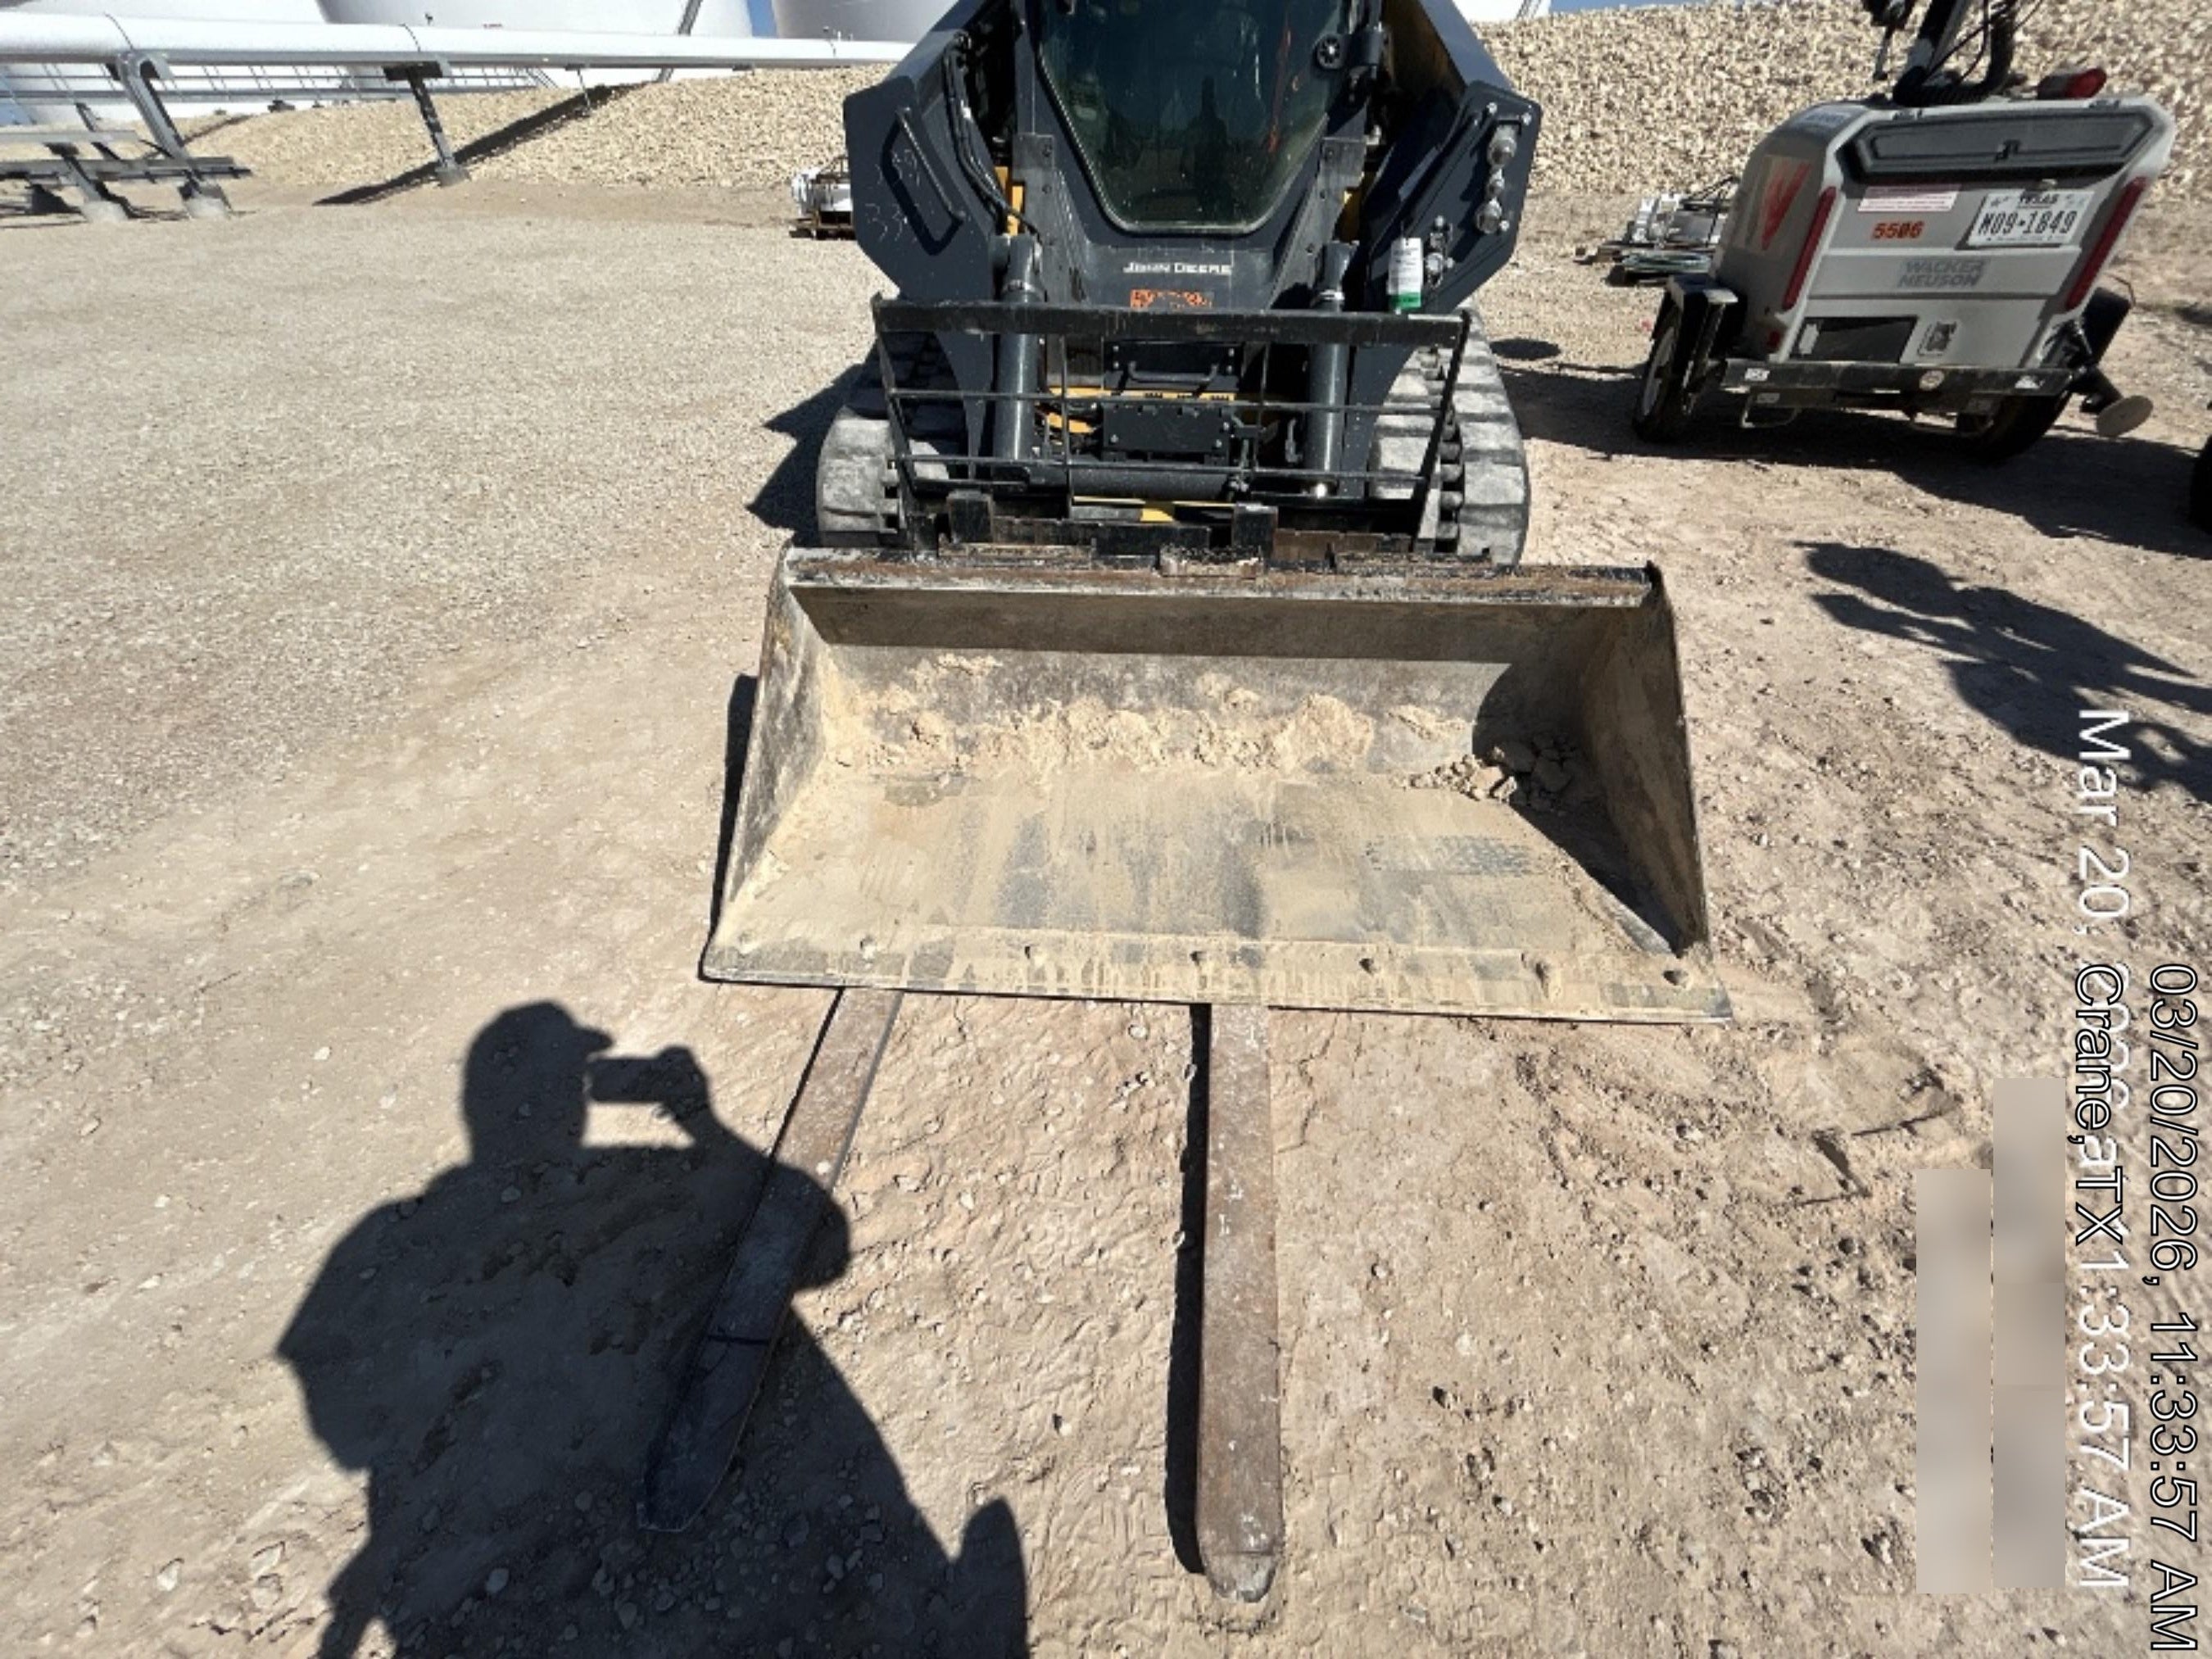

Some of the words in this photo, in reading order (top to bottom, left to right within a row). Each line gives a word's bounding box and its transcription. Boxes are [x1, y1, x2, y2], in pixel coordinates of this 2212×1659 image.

[1871, 221, 1924, 239] 5506
[1122, 261, 1171, 274] JOHN
[1174, 262, 1232, 275] DEERE
[1905, 260, 1985, 273] WACKER
[1897, 274, 1980, 287] NEUSON
